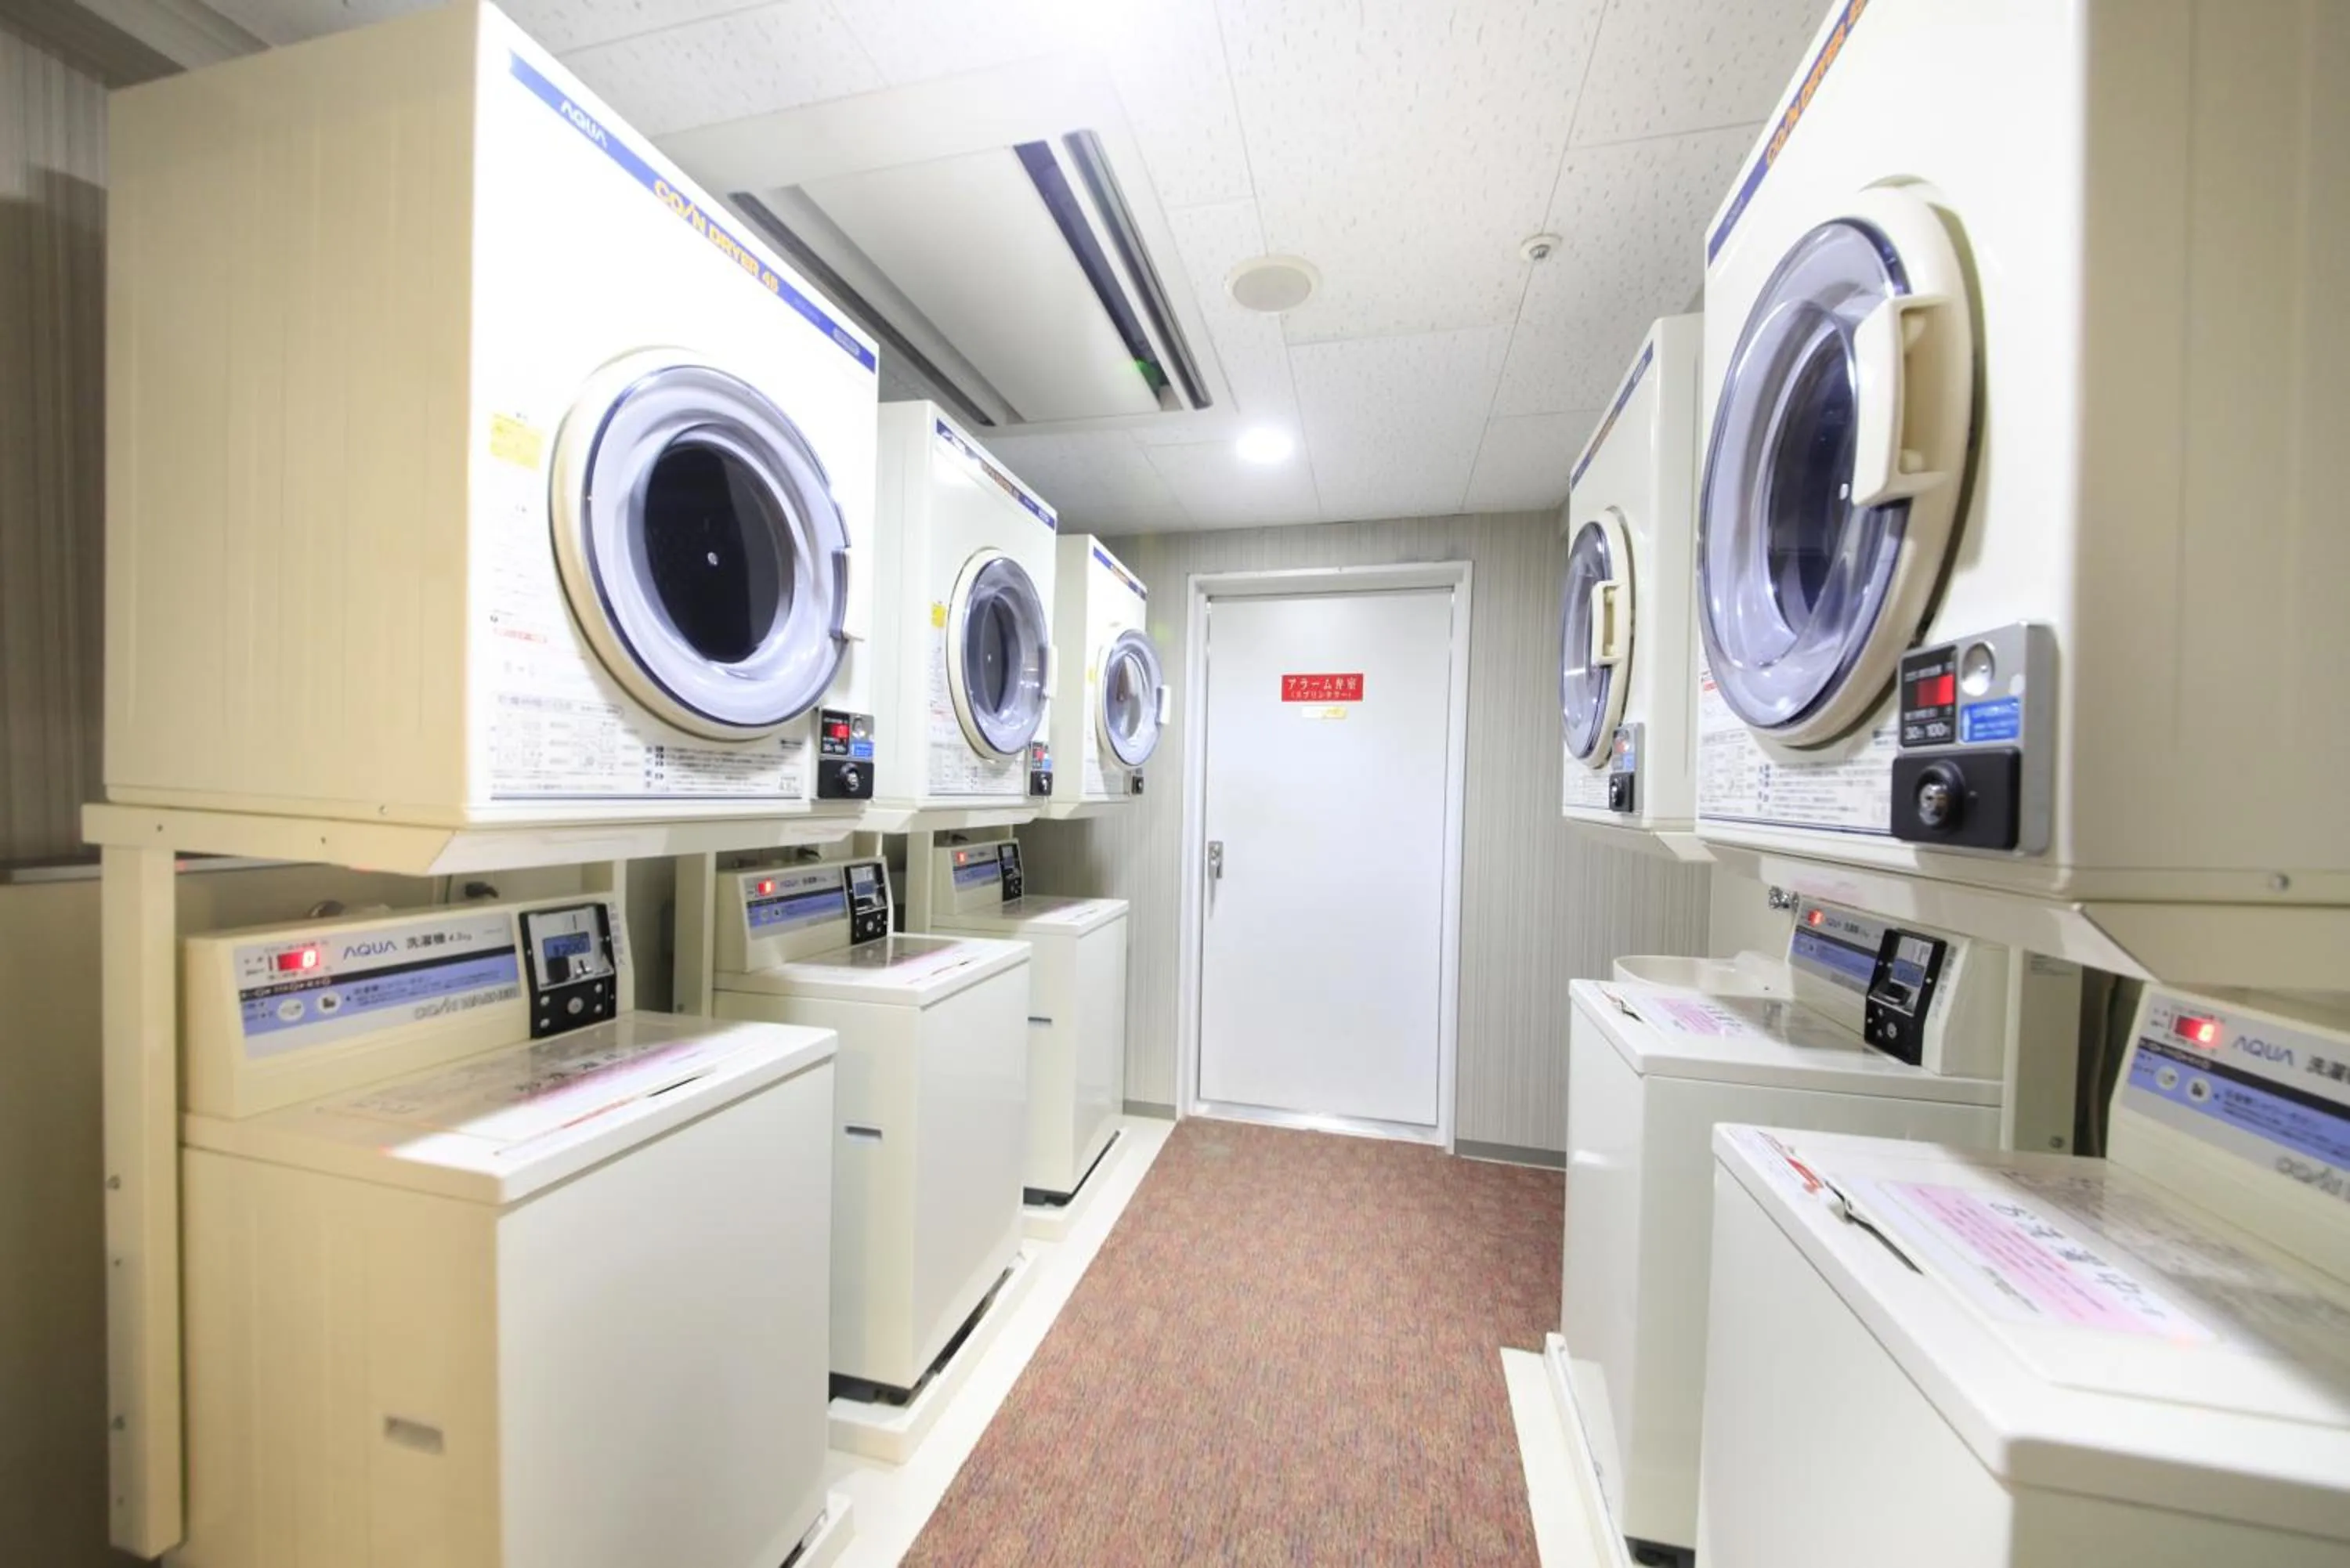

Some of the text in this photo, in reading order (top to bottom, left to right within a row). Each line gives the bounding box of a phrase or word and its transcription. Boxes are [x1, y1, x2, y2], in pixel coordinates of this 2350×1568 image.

[560, 100, 608, 150] AQUA
[709, 224, 759, 276] DRYER
[343, 940, 398, 959] AQUA
[2232, 1035, 2294, 1067] AQUA
